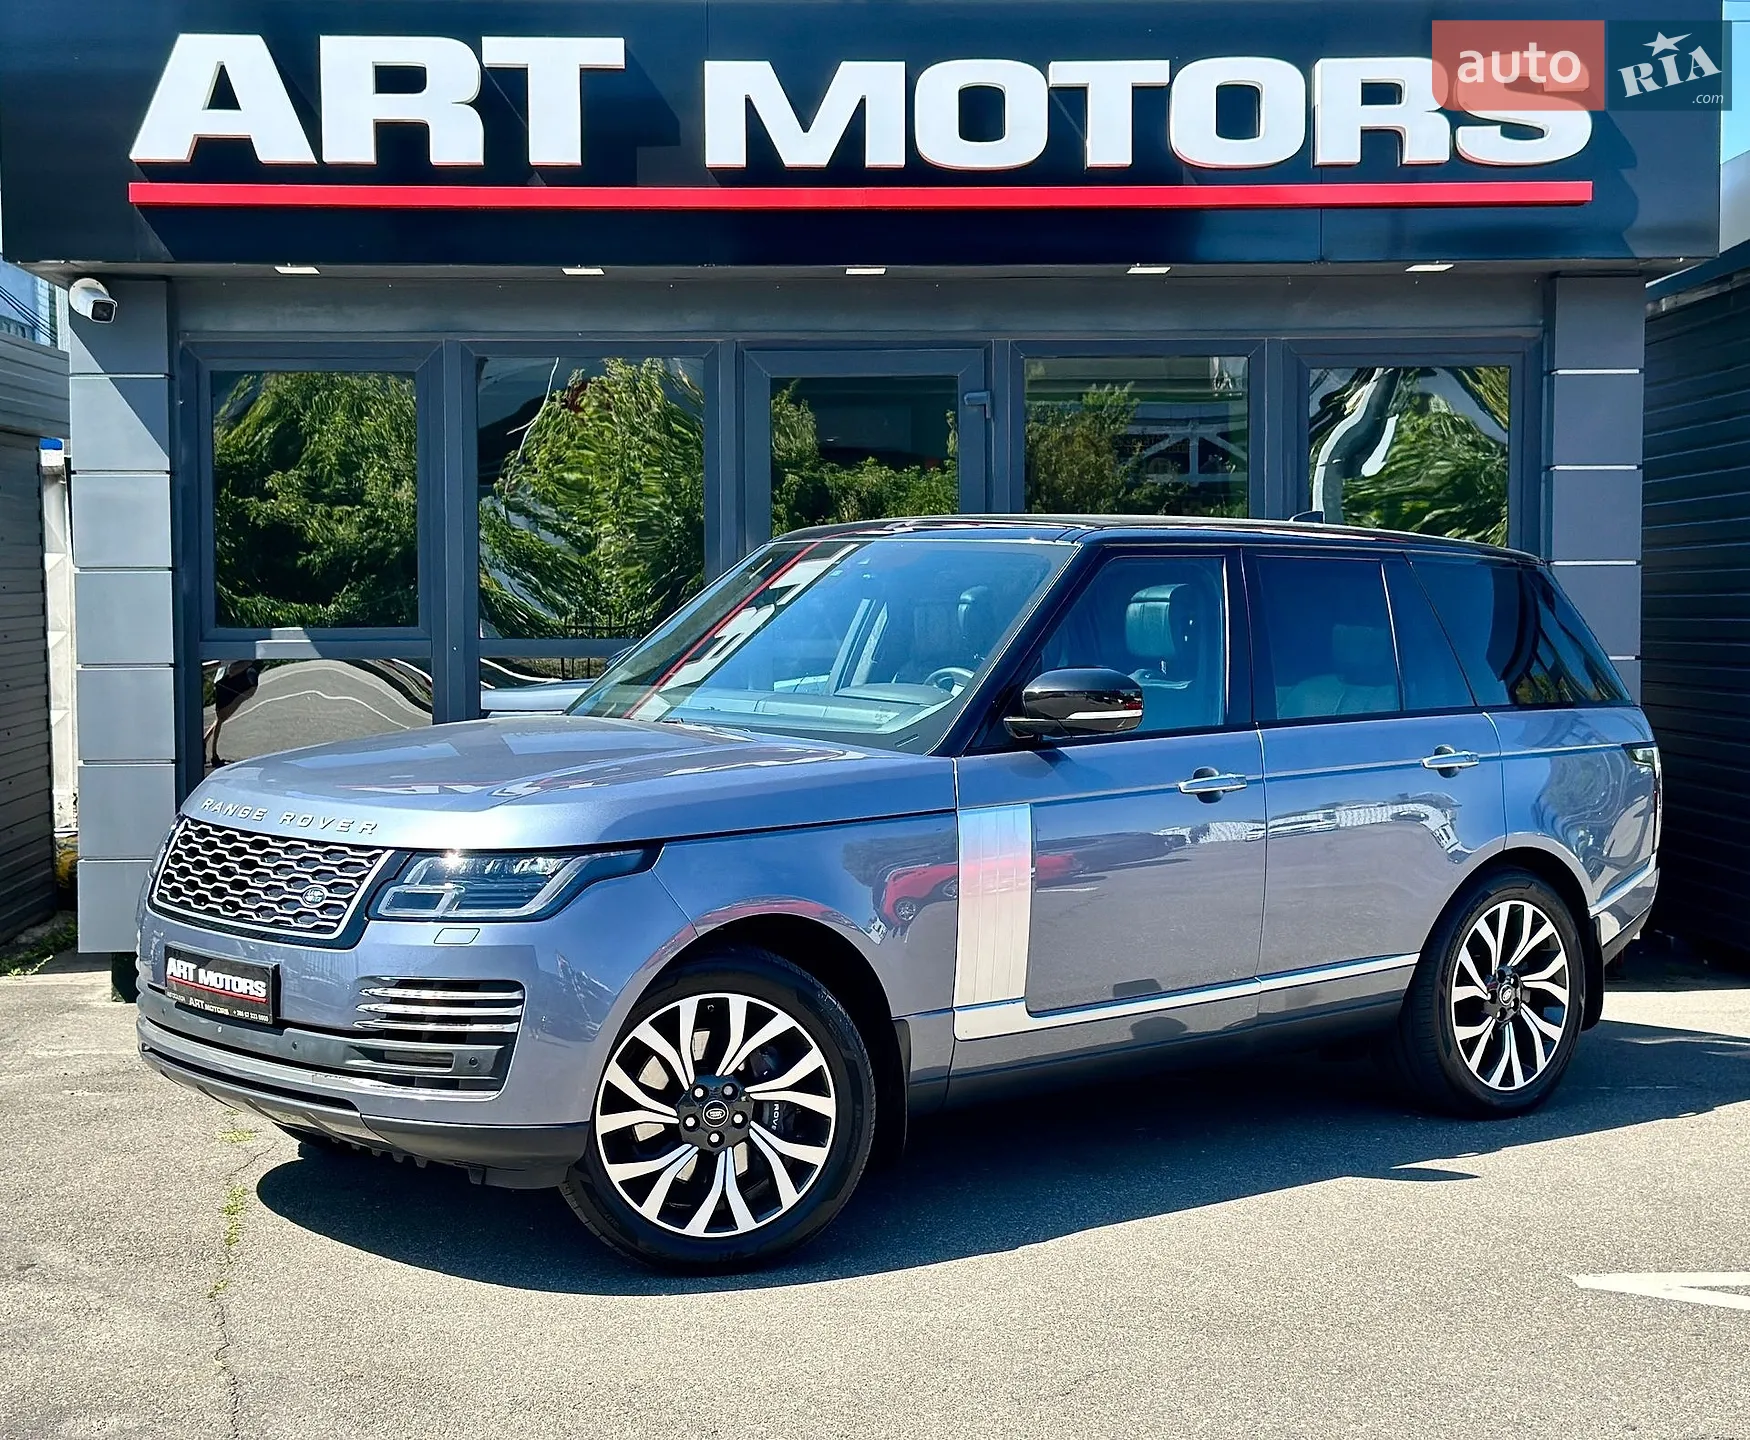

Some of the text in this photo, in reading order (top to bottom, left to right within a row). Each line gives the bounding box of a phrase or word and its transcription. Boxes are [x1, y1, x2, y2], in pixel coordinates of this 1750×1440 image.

[129, 33, 1592, 168] ART MOTORS
[201, 797, 378, 835] RANGE ROVER
[166, 957, 197, 981] ART
[198, 968, 267, 998] MOTORS
[189, 998, 205, 1009] ART
[771, 1103, 780, 1130] ROVE
